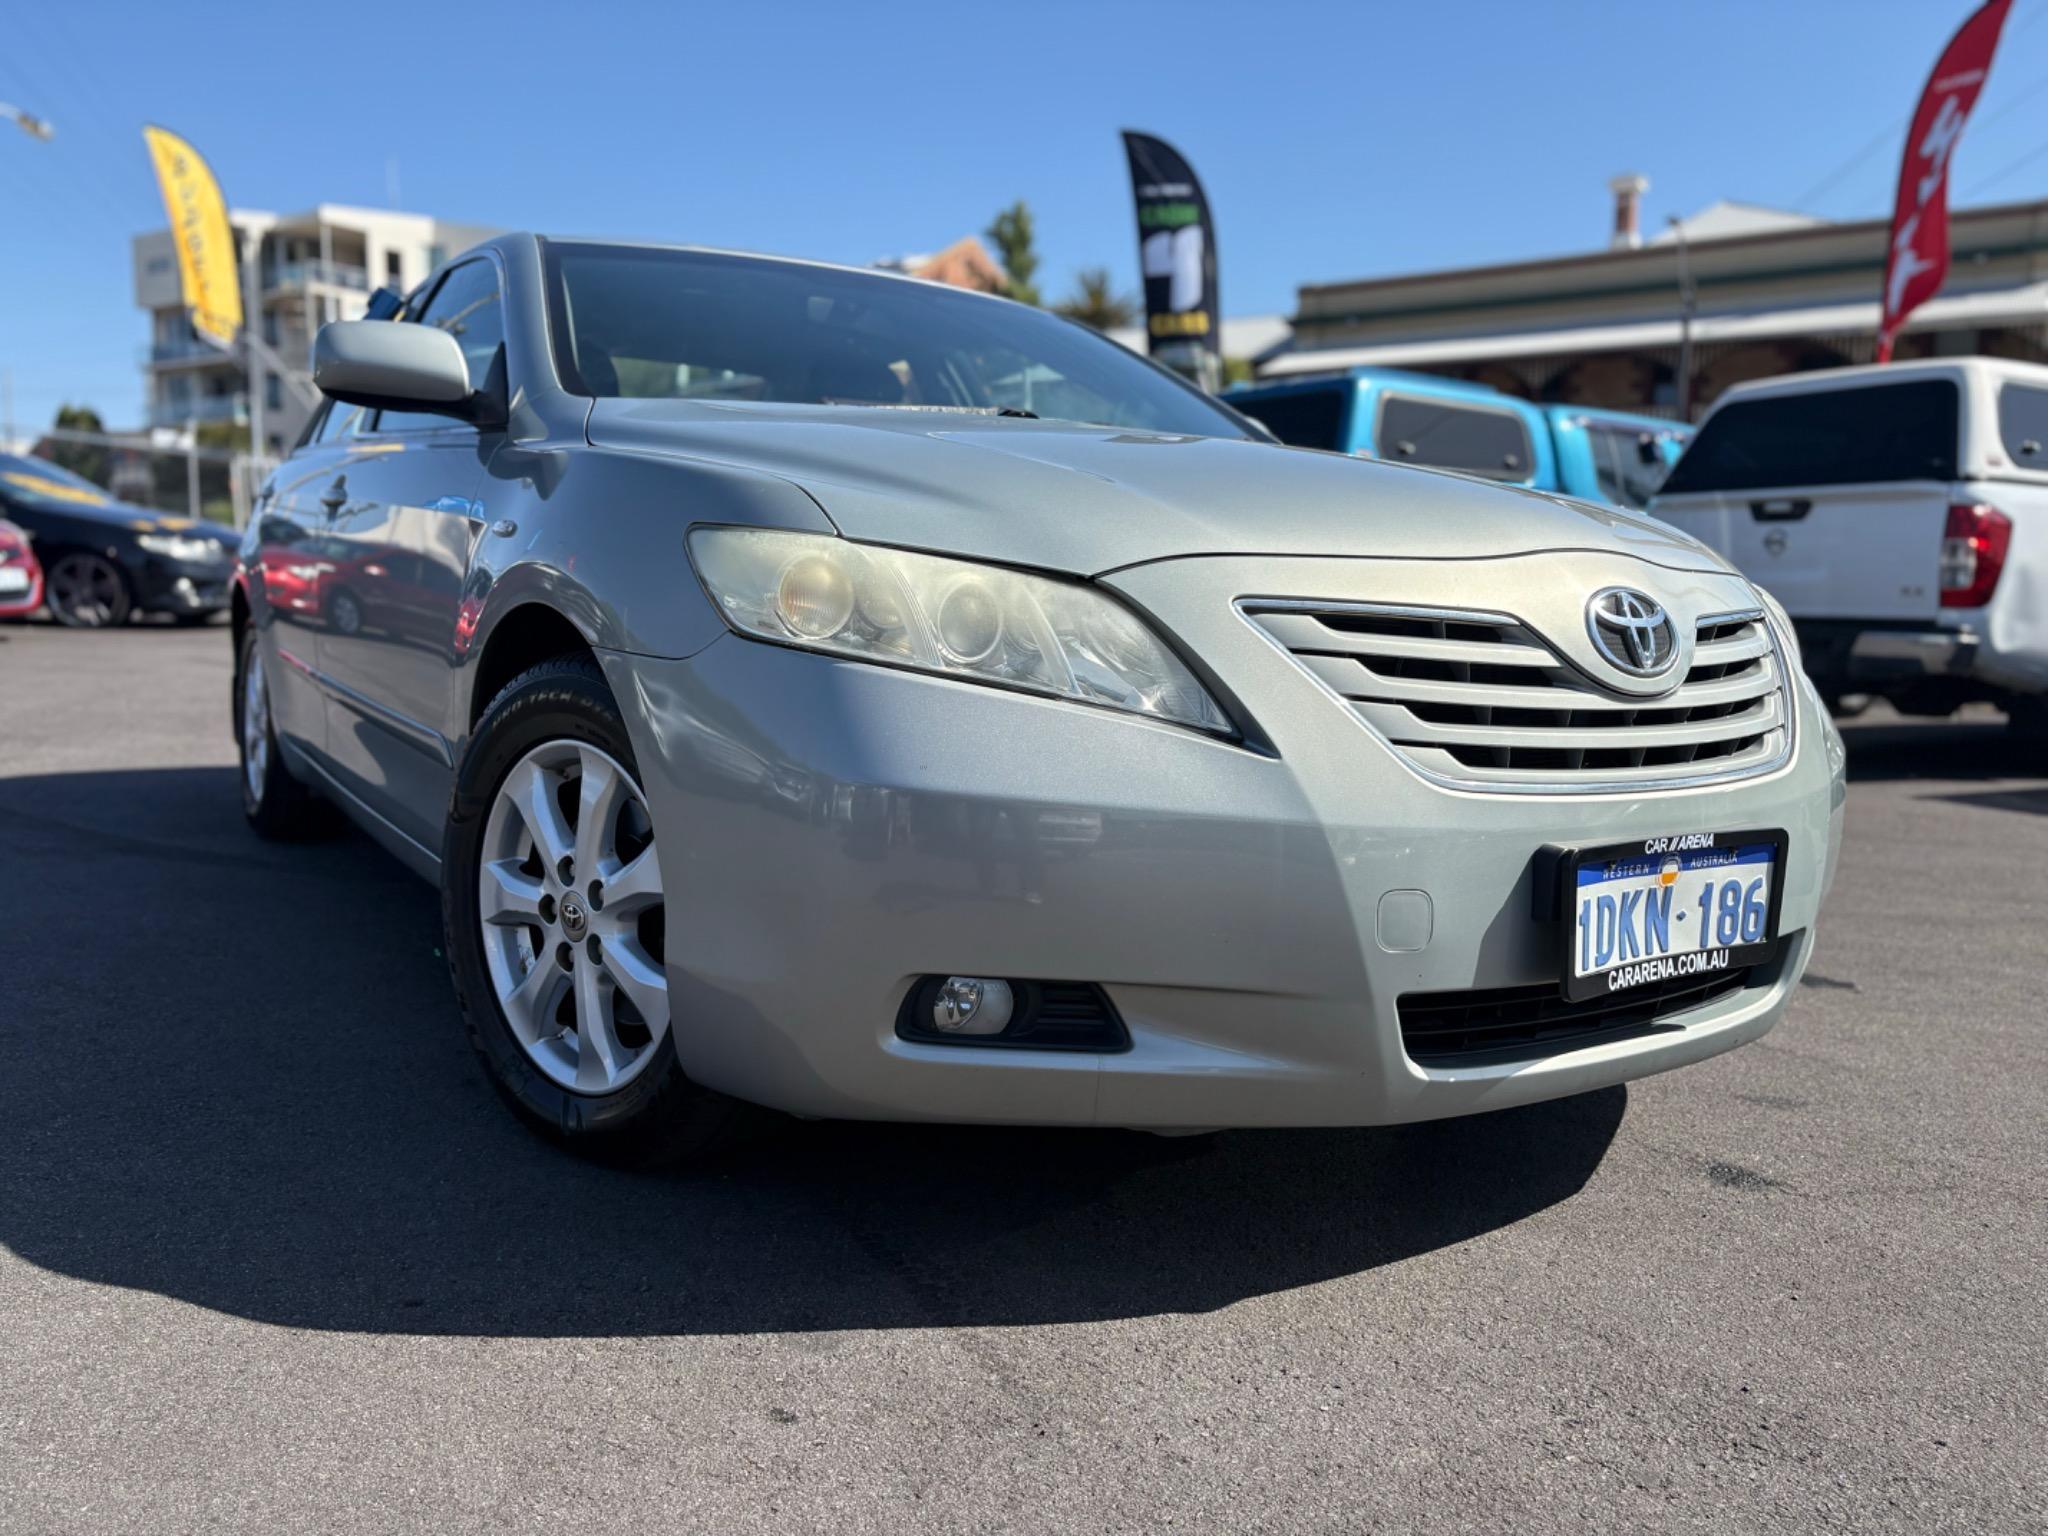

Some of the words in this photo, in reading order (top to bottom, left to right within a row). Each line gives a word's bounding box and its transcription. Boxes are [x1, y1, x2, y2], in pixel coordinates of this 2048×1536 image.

[1690, 853, 1738, 868] AUSTRALIA
[1579, 885, 1673, 972] 1DKN
[1699, 875, 1766, 949] 186
[1608, 949, 1729, 991] CARARENA.COM.AU
